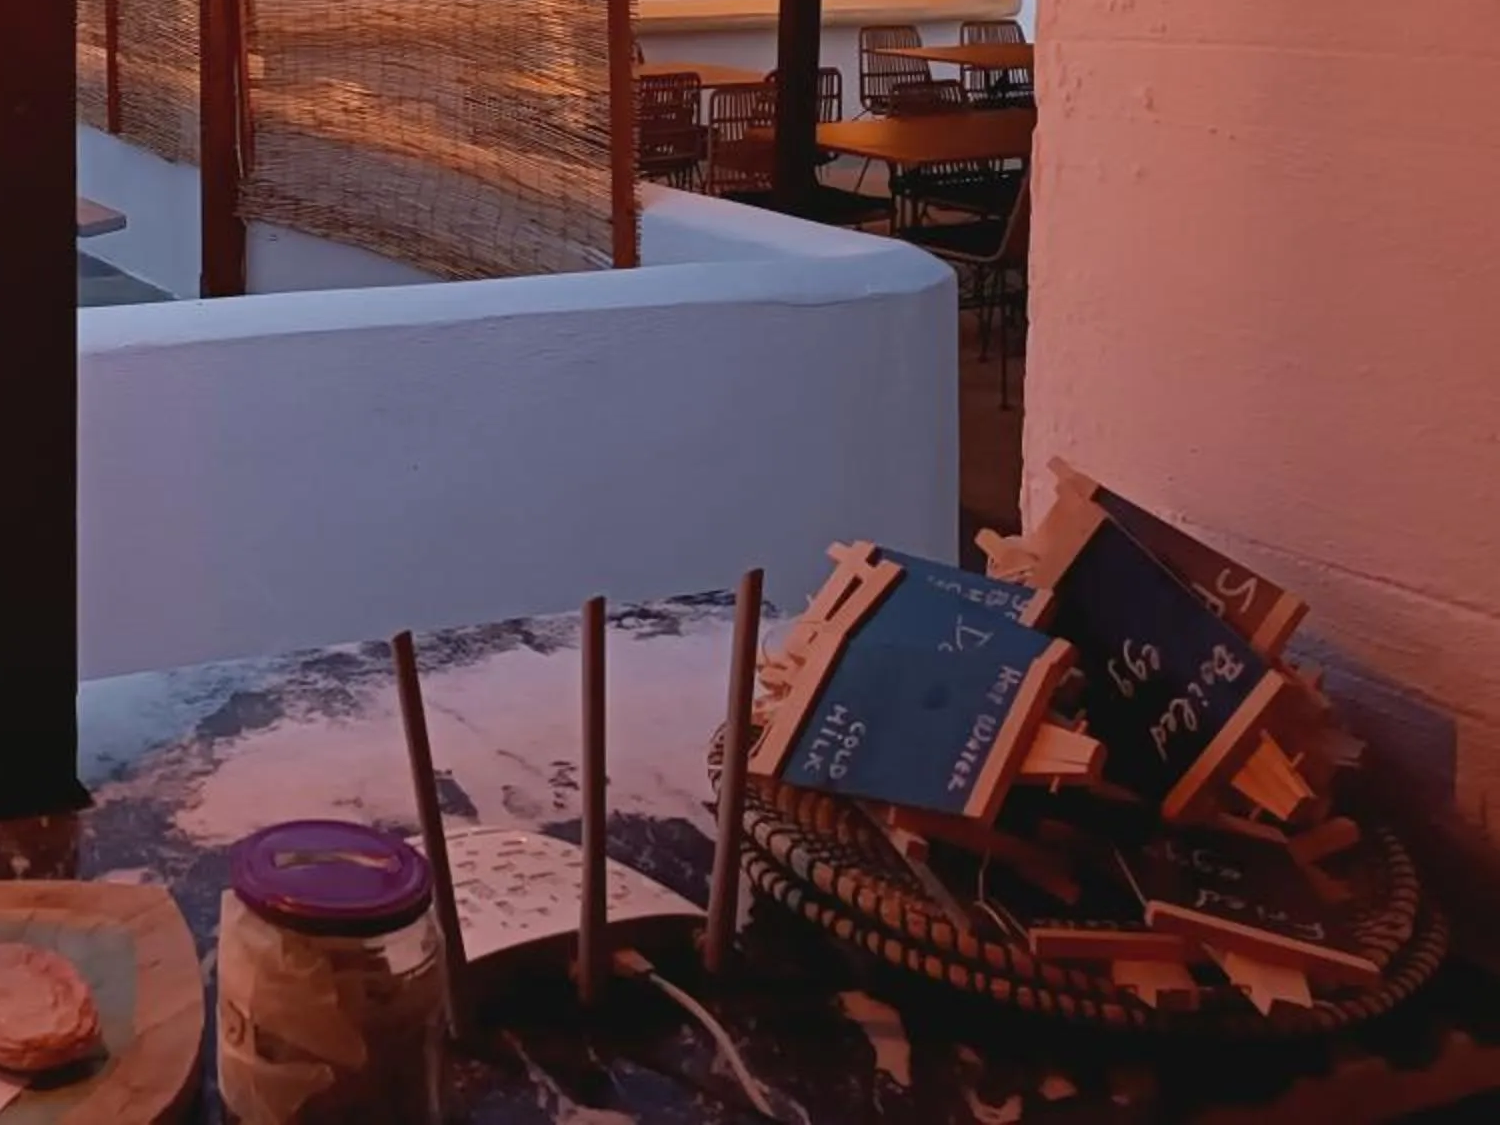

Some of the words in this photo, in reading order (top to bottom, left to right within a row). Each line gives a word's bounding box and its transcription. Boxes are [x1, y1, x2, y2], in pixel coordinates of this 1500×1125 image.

[1107, 638, 1161, 699] egg
[1150, 644, 1245, 762] Boiled
[829, 720, 867, 780] COLD
